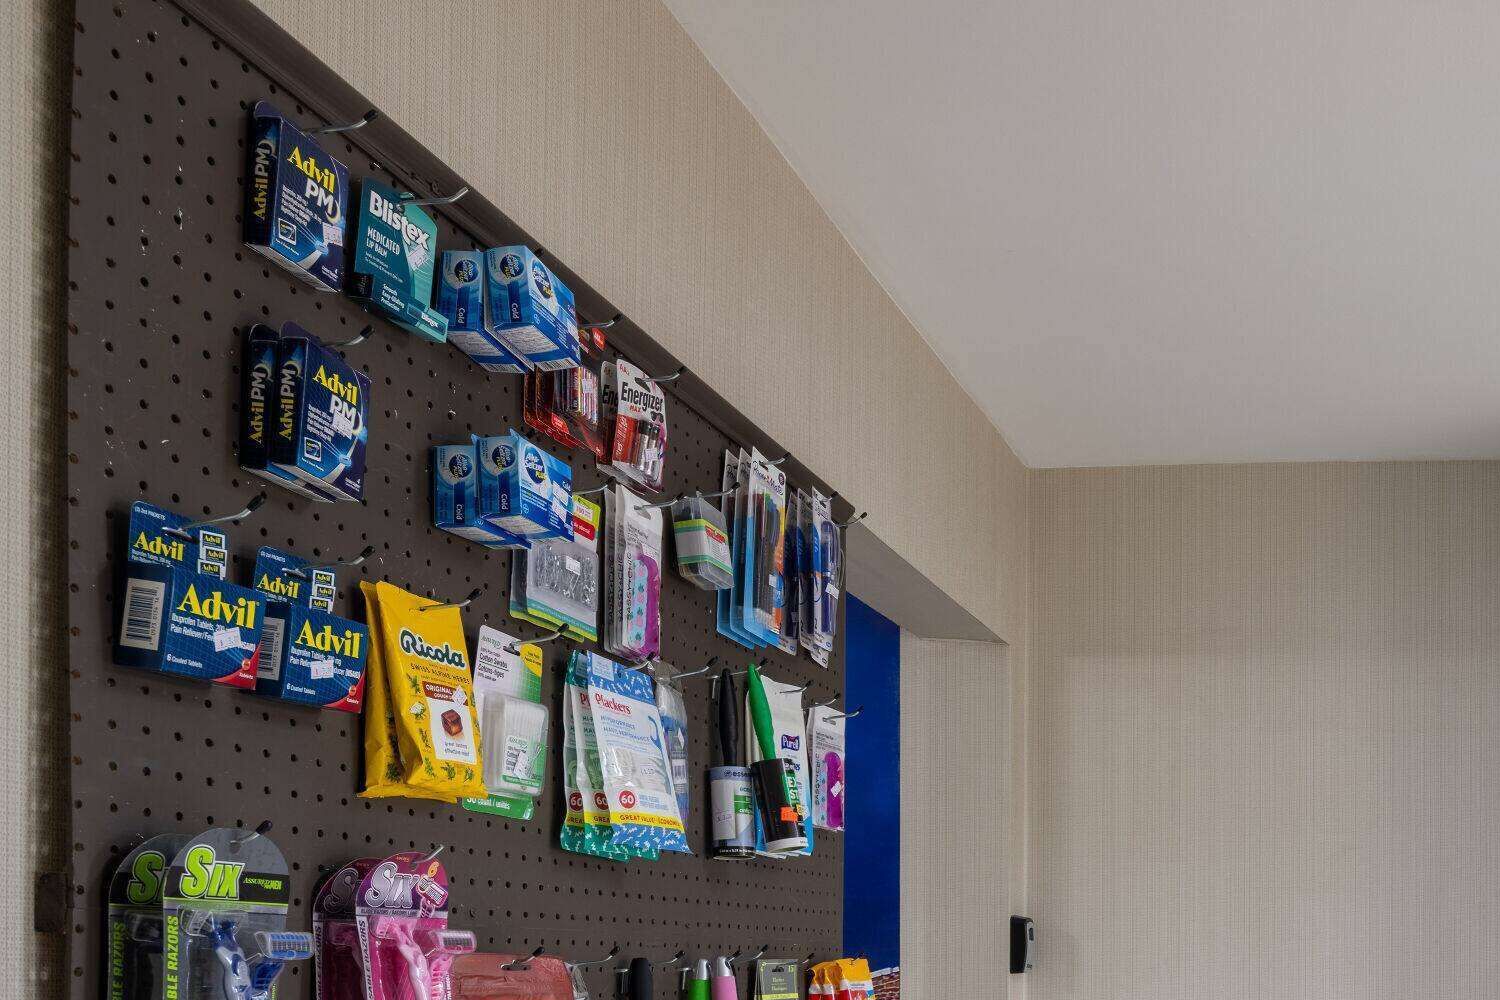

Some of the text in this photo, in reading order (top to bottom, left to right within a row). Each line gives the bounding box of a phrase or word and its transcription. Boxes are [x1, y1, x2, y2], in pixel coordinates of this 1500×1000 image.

[254, 147, 270, 220] Advil PM
[287, 146, 335, 193] Advil
[305, 178, 335, 214] PM
[369, 190, 430, 248] Blistex
[367, 226, 400, 256] MEDICATED
[511, 303, 519, 319] Cold
[313, 364, 357, 406] Advil
[621, 381, 664, 412] Energizer
[248, 371, 265, 444] Advil PM
[279, 368, 297, 441] Advil PM
[629, 404, 641, 413] MAX
[134, 531, 184, 562] Advil
[204, 535, 221, 544] Advil
[207, 550, 224, 559] Advil
[202, 562, 219, 573] Advil
[316, 573, 331, 582] Advil
[257, 573, 300, 599] Advil
[177, 584, 256, 630] Advil
[313, 599, 327, 608] Advil
[170, 624, 182, 633] Pain
[172, 614, 196, 626] Ibuprofen
[295, 619, 361, 658] Advil
[400, 628, 467, 670] Ricola
[480, 653, 494, 664] Cotton
[425, 684, 453, 695] ORIGINAL
[595, 692, 632, 715] Plackers
[622, 795, 634, 804] 60
[181, 845, 246, 900] SIX
[365, 862, 420, 908] SIX
[114, 922, 127, 974] RAZORS
[168, 916, 179, 970] RAZORS
[357, 920, 372, 970] RAZORS
